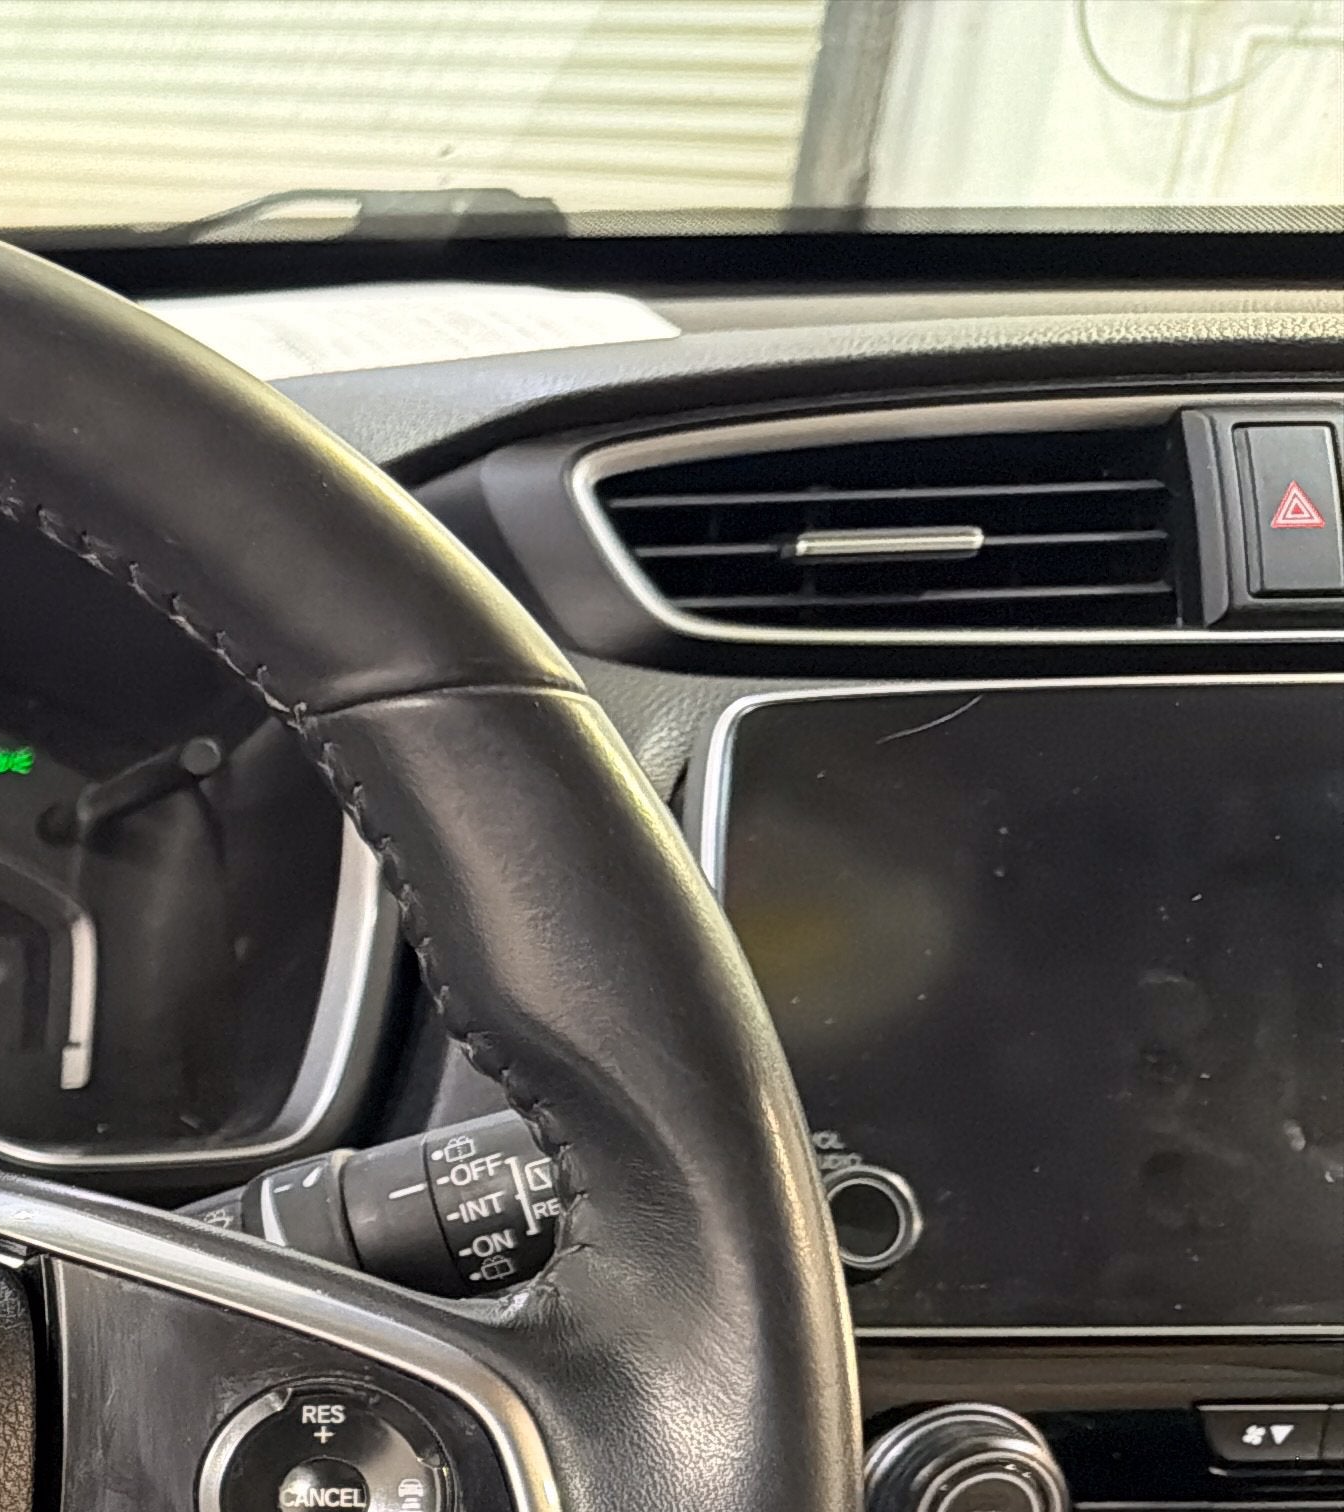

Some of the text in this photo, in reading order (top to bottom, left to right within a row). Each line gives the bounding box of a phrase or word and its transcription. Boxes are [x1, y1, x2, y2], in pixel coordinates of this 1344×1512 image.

[450, 1152, 503, 1186] OFF
[459, 1191, 505, 1223] INT
[472, 1229, 515, 1257] ON
[301, 1405, 345, 1424] RES
[279, 1488, 366, 1508] CANCEL
